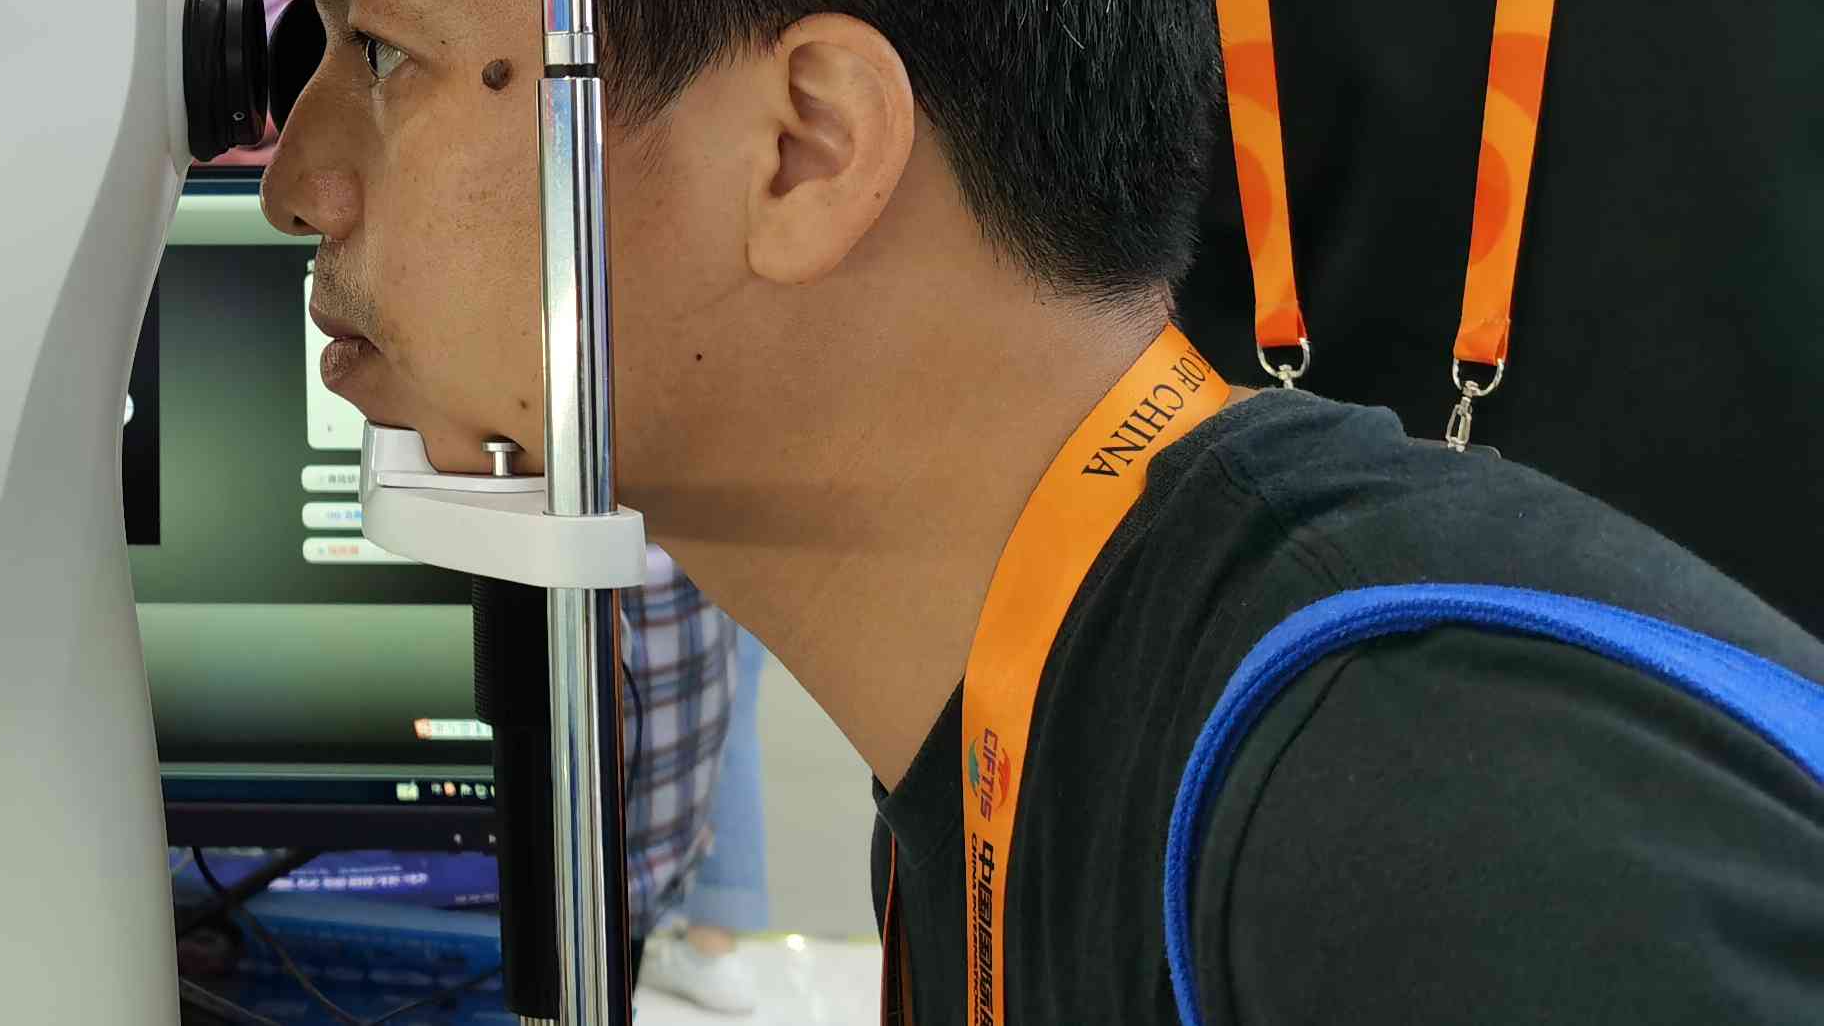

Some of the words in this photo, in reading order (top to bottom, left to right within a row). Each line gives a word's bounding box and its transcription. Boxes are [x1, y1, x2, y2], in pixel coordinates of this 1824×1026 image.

[1170, 357, 1206, 393] OF
[1081, 384, 1184, 478] CHINA
[980, 727, 998, 823] CIFTIS
